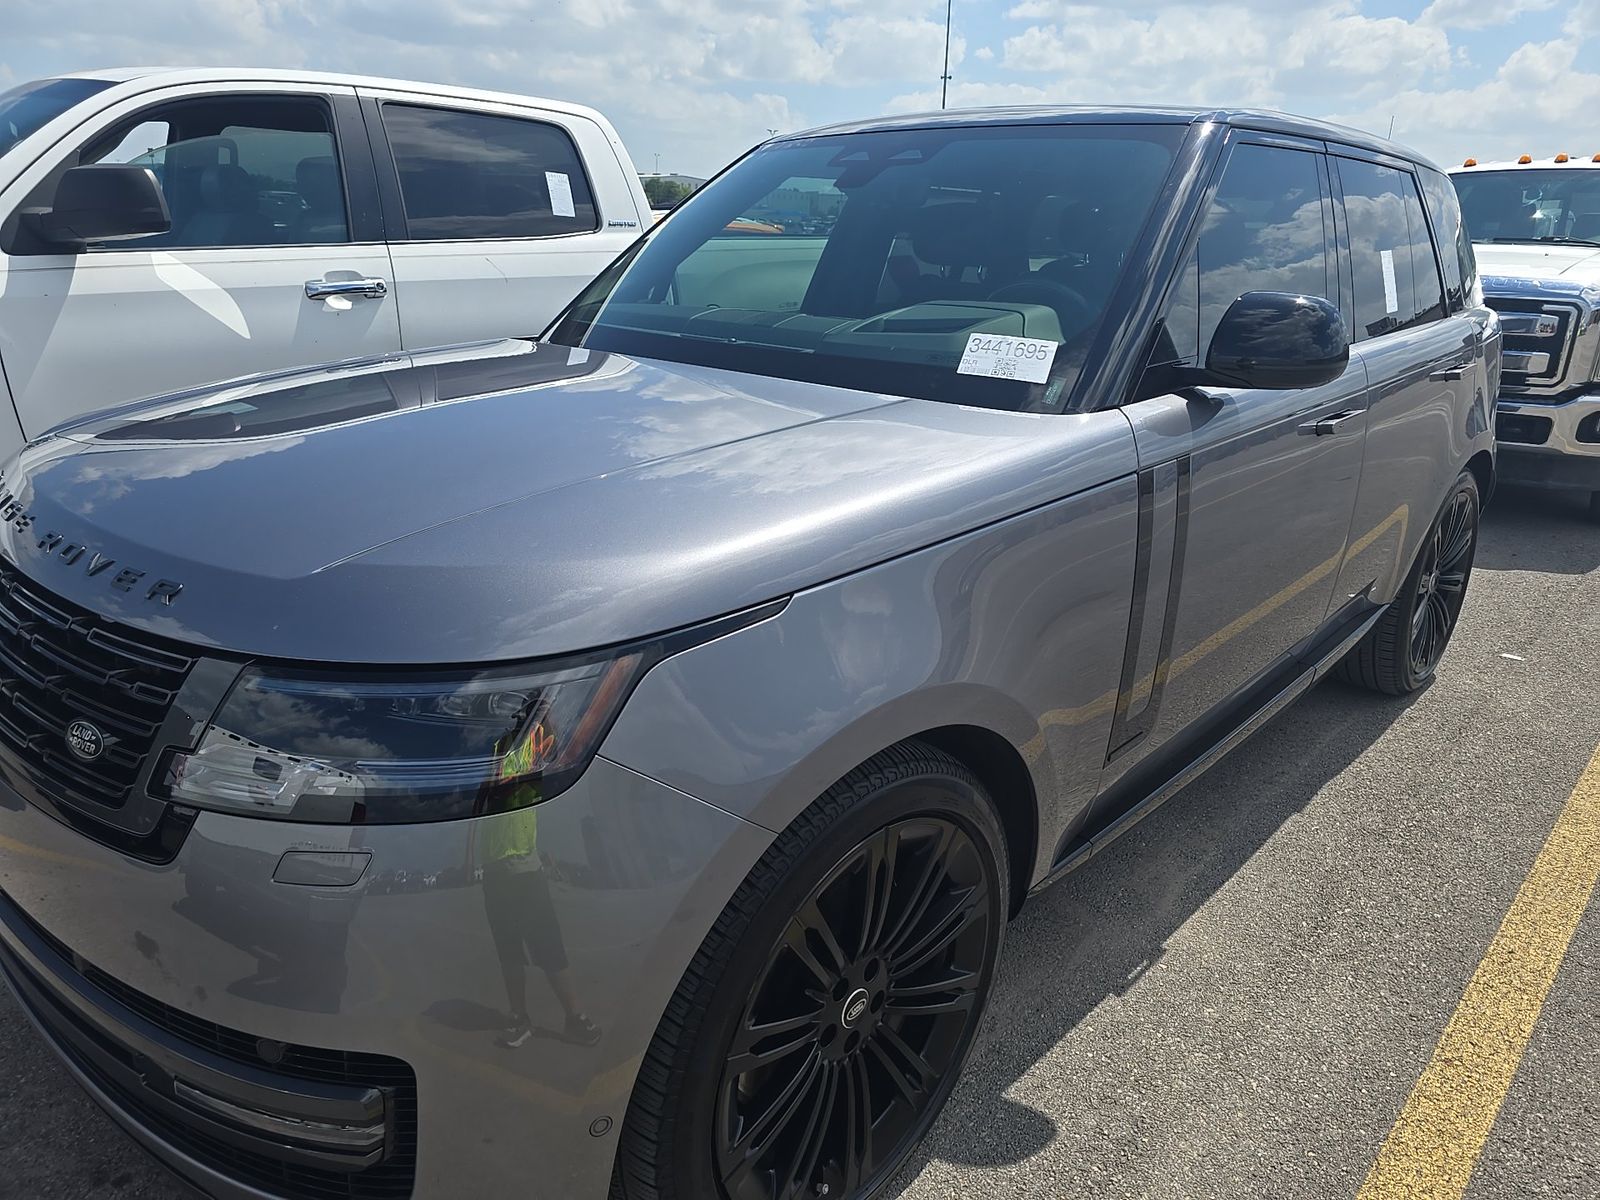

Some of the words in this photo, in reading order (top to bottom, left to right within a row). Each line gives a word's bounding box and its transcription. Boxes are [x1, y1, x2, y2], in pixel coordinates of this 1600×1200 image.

[969, 337, 1050, 361] 3441695
[36, 530, 185, 607] ROVER
[72, 724, 93, 741] LAND
[71, 736, 96, 755] ROVER
